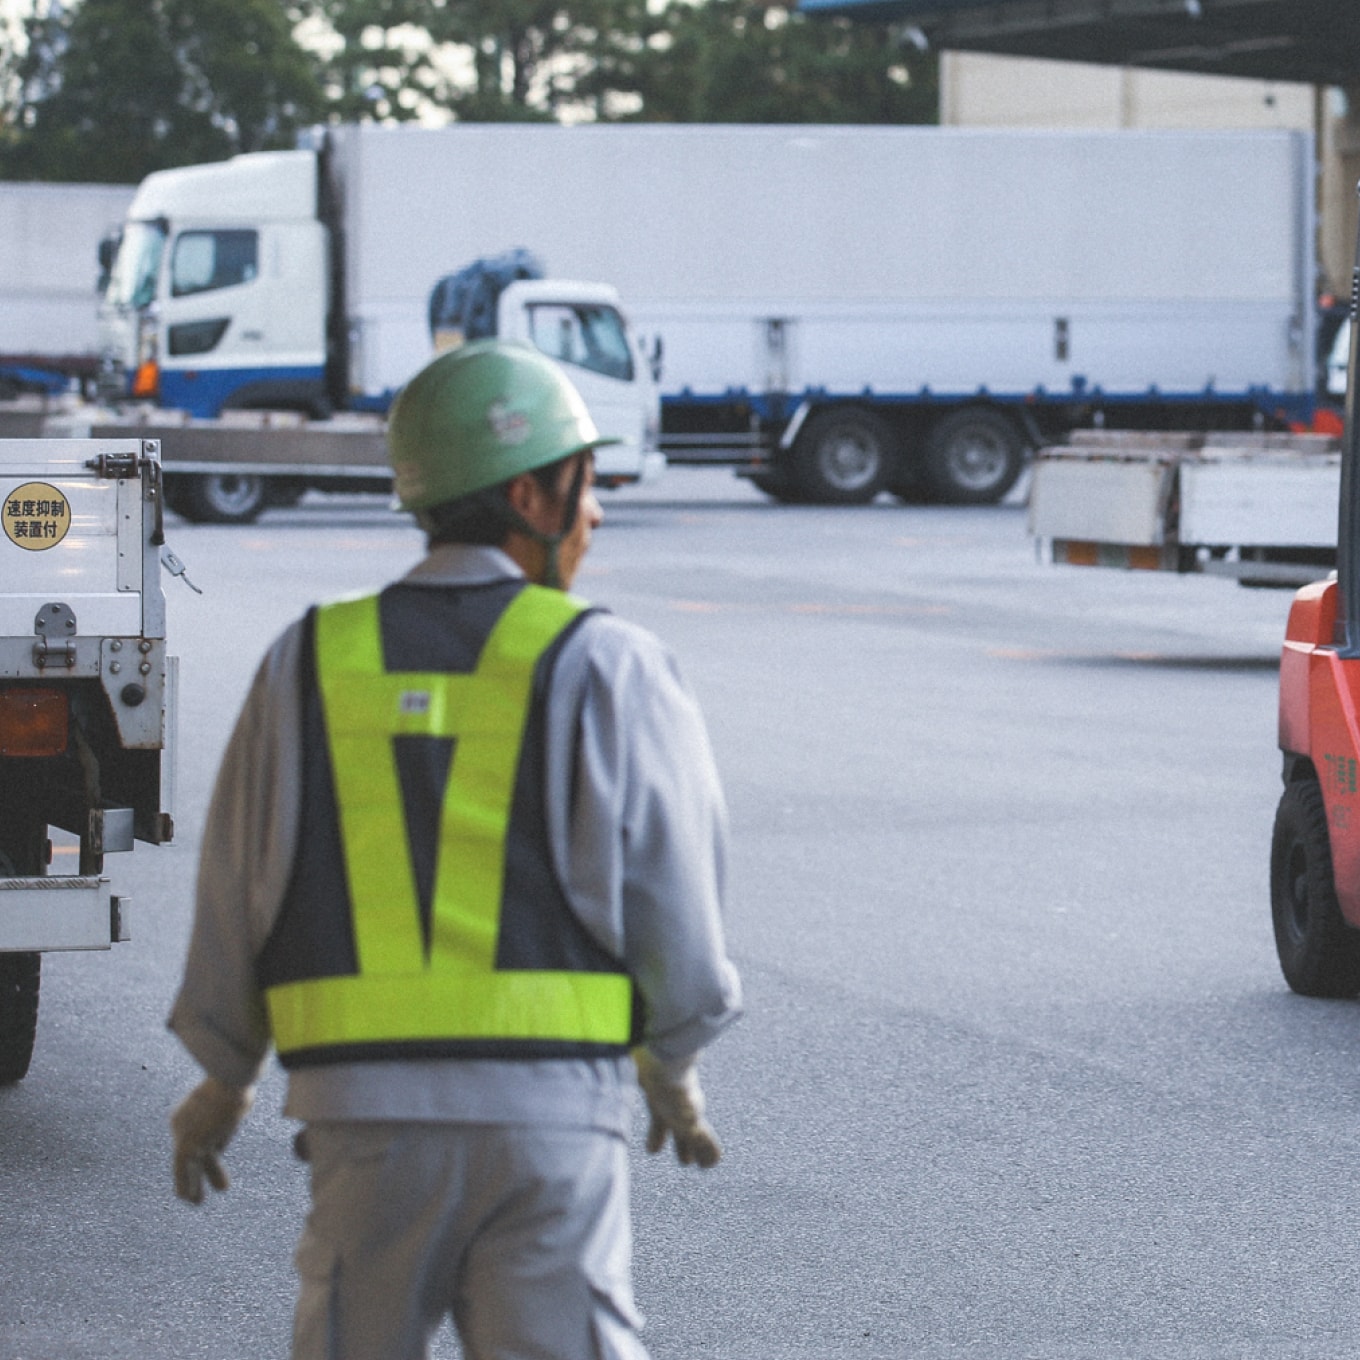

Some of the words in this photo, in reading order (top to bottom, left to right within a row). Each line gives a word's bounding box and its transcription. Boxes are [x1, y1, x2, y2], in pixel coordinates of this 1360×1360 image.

[7, 499, 65, 517] 速度抑制
[13, 520, 58, 538] 装置付
